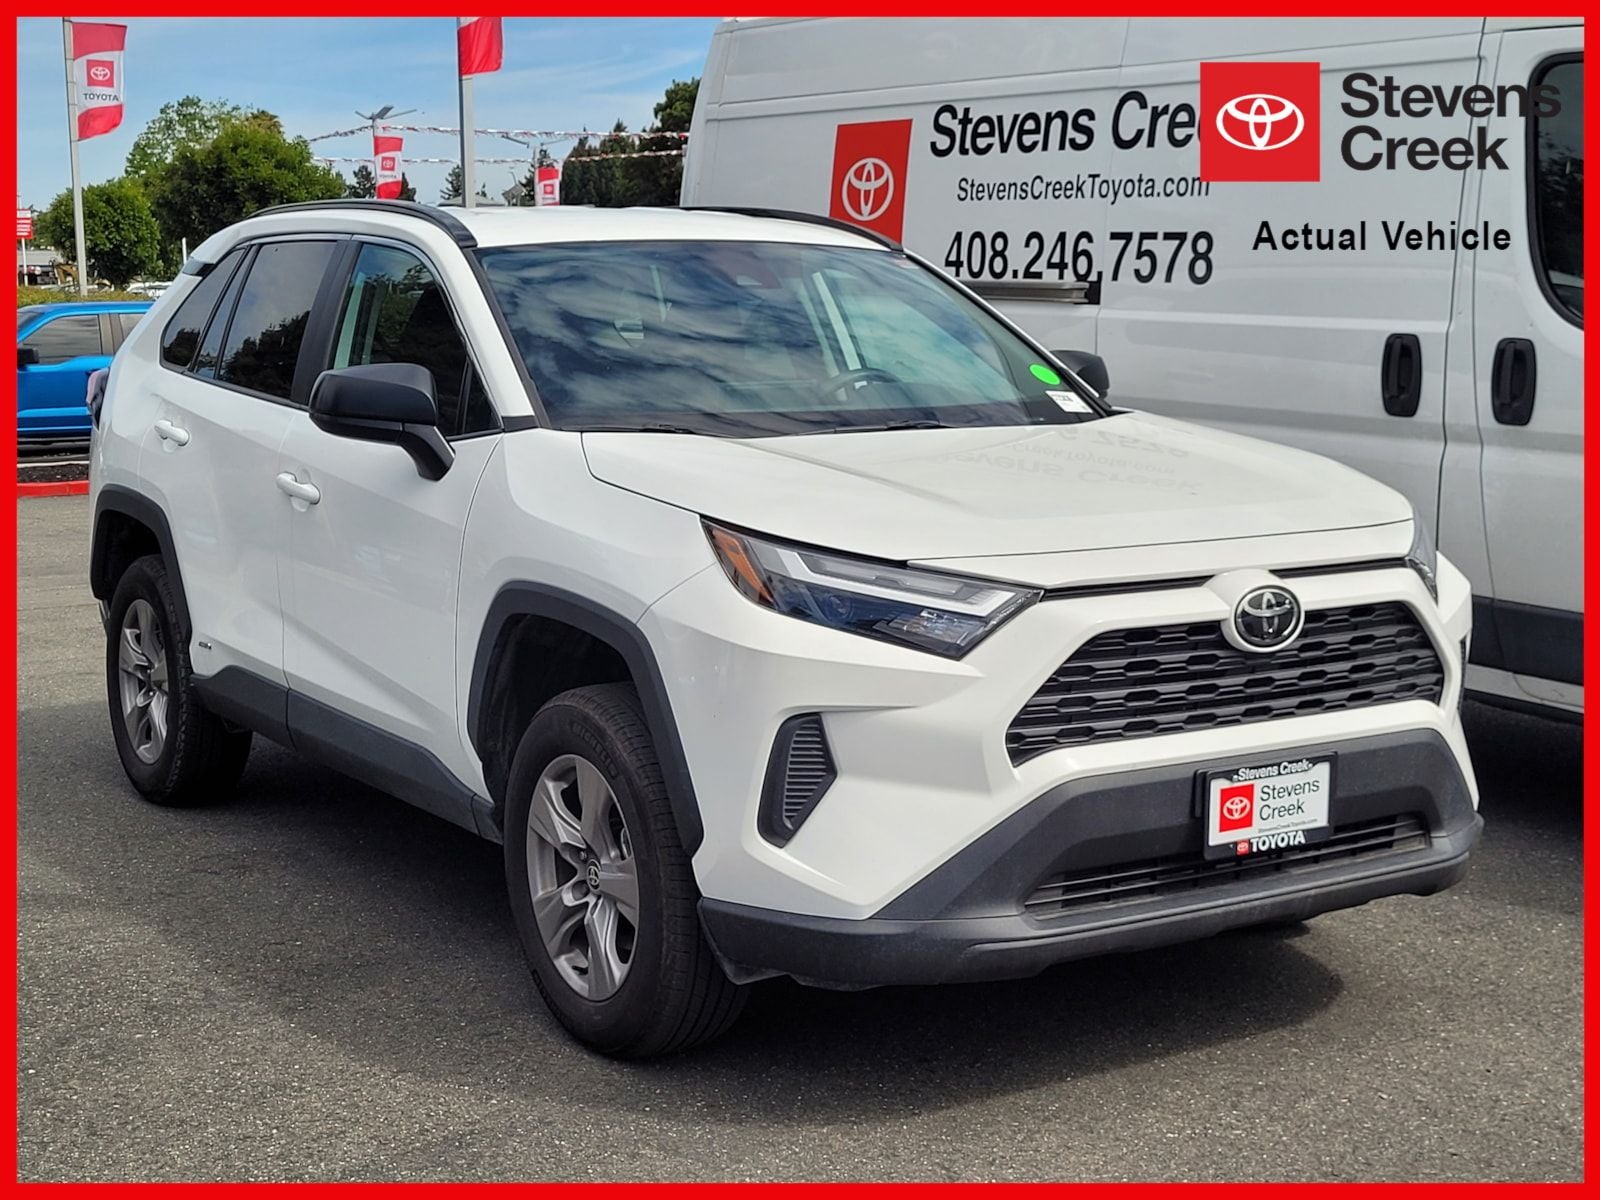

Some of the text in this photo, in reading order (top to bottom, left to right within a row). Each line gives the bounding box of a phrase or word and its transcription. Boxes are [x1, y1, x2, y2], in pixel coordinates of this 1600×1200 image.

[82, 92, 120, 102] TOYOTA
[930, 90, 1200, 158] Stevens Cre
[956, 173, 1211, 206] StevensCreekToyota.com
[944, 229, 1214, 286] 408.246.7578
[1238, 759, 1308, 781] Stevens Creek
[1259, 779, 1320, 802] Stevens
[1259, 799, 1305, 821] Creek
[1251, 831, 1305, 852] TOYOTA
